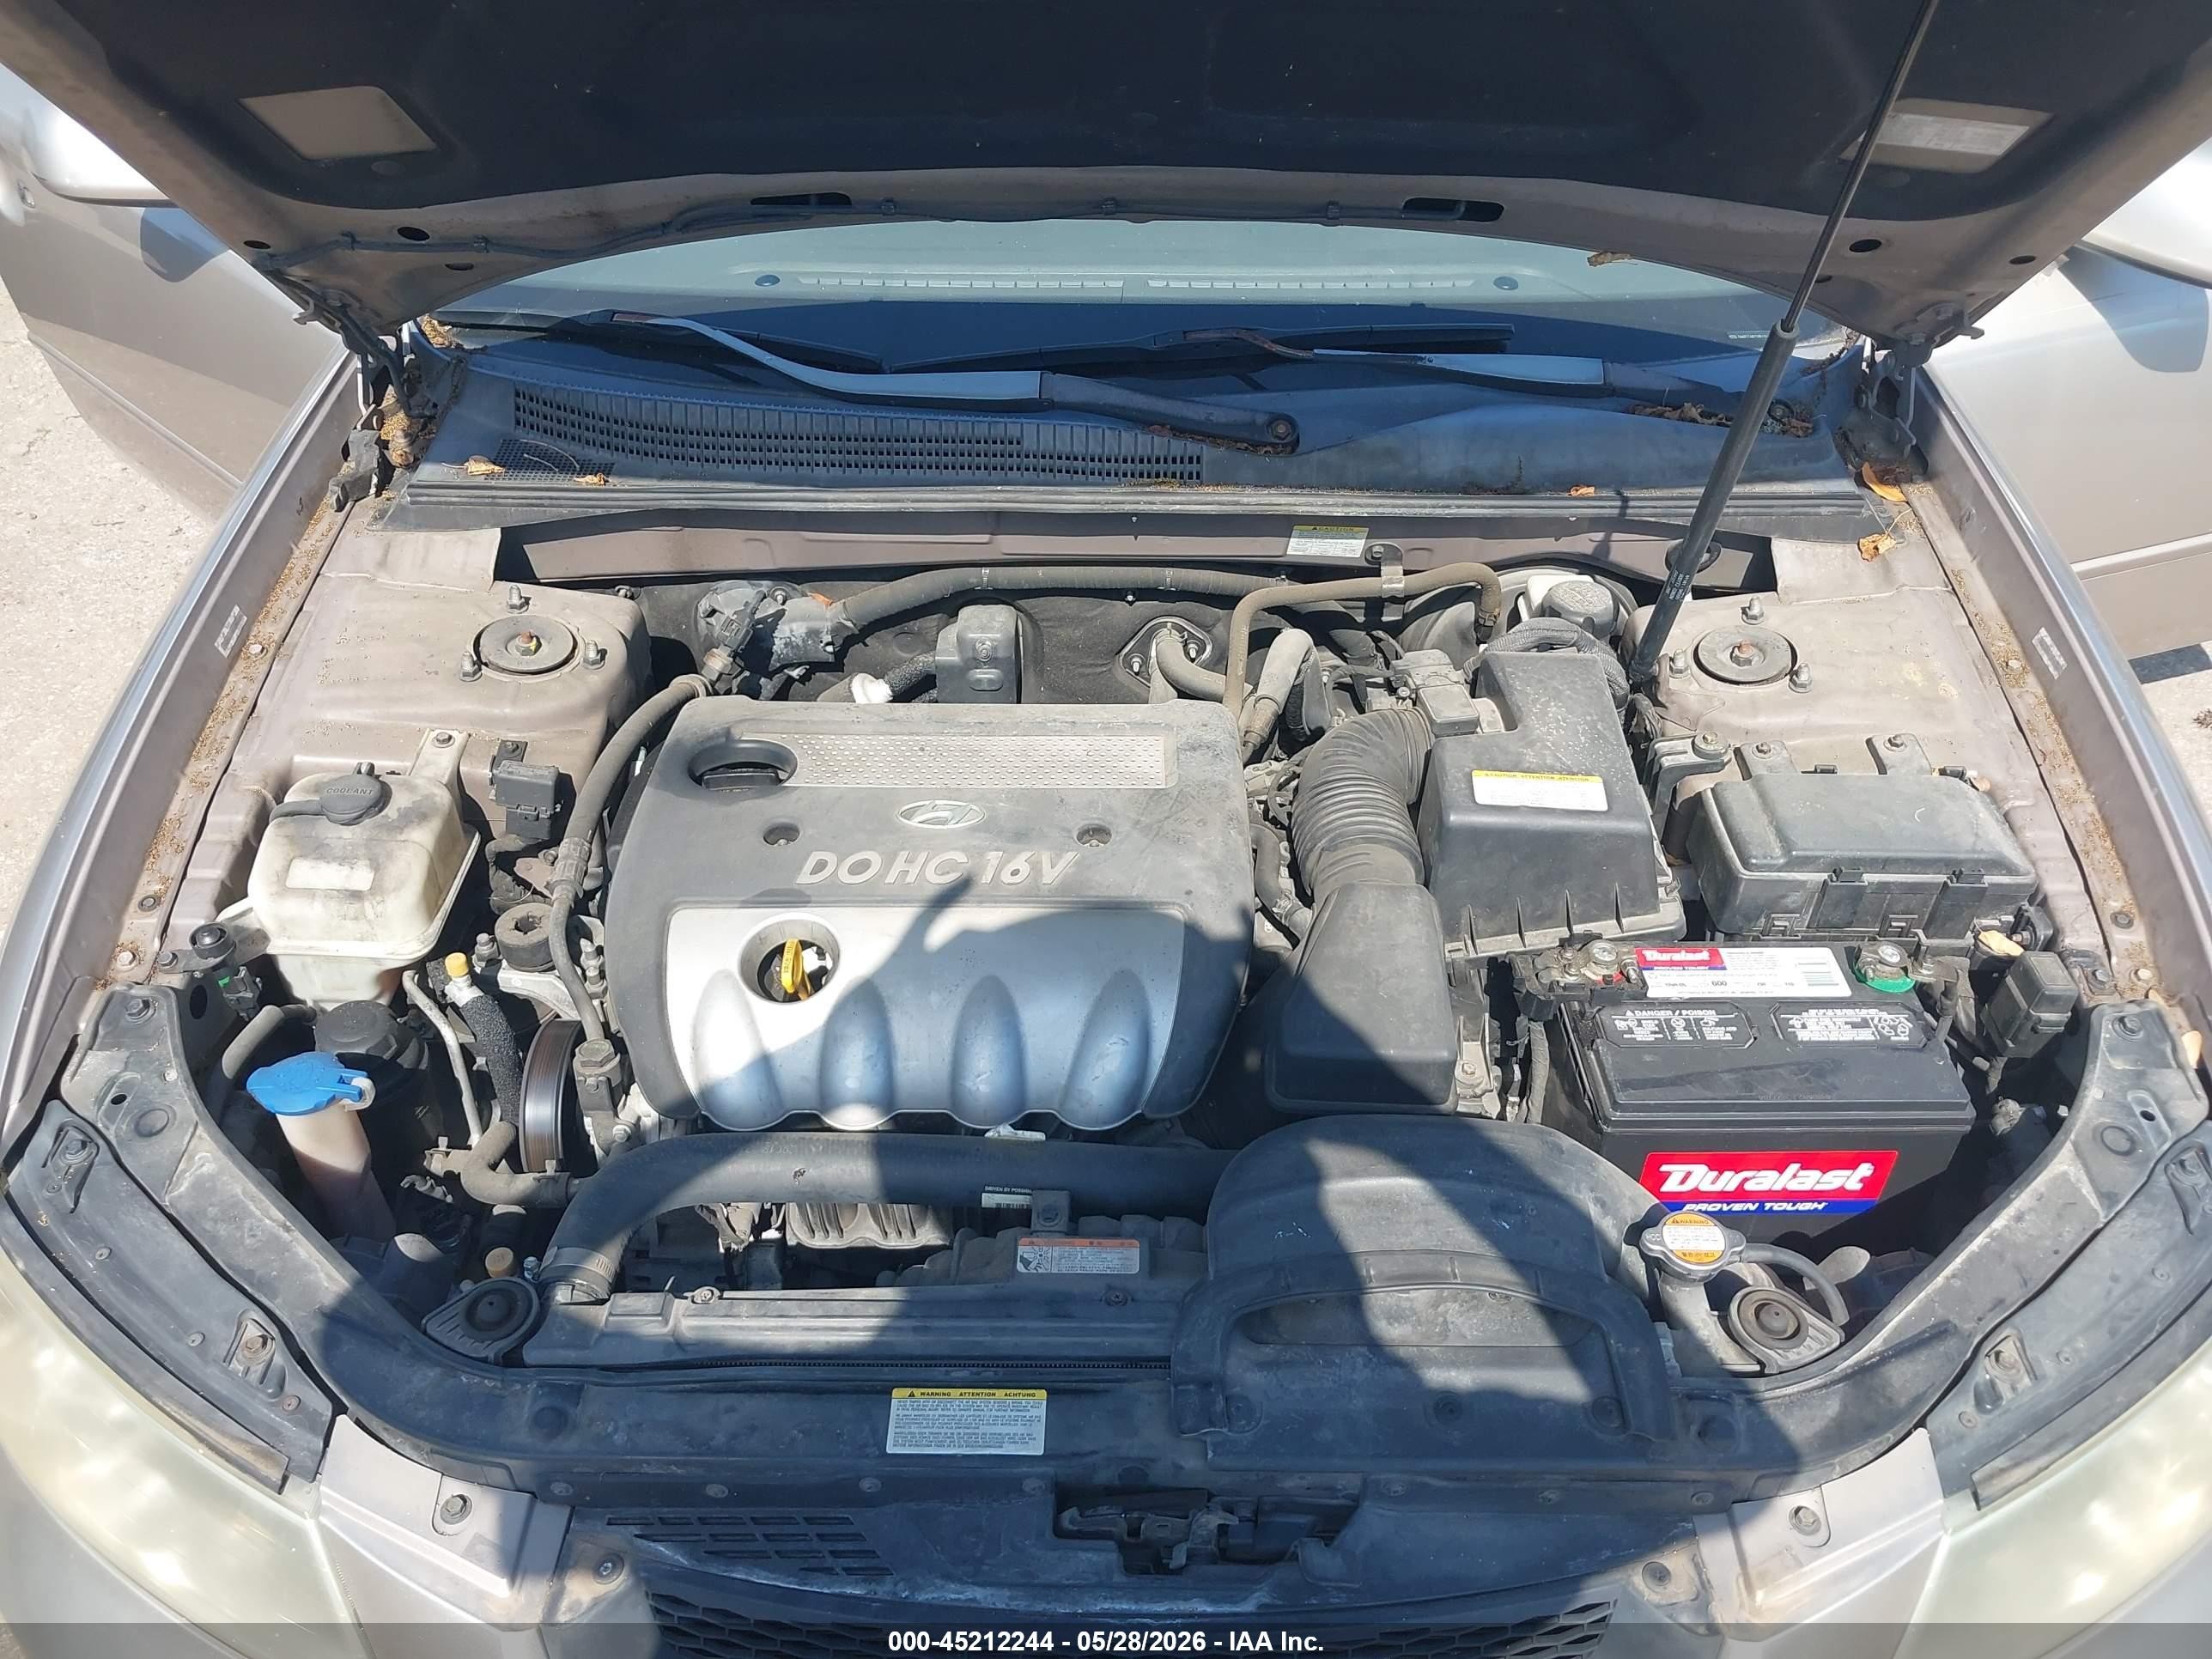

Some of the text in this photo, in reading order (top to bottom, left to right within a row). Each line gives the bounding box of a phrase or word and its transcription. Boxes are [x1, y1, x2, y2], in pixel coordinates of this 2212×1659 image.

[796, 850, 1080, 885] DOHC 16V
[1642, 949, 1711, 962] Duralast
[1658, 1162, 1875, 1193] Duralast
[1682, 1201, 1827, 1212] PROVEN TOUGH
